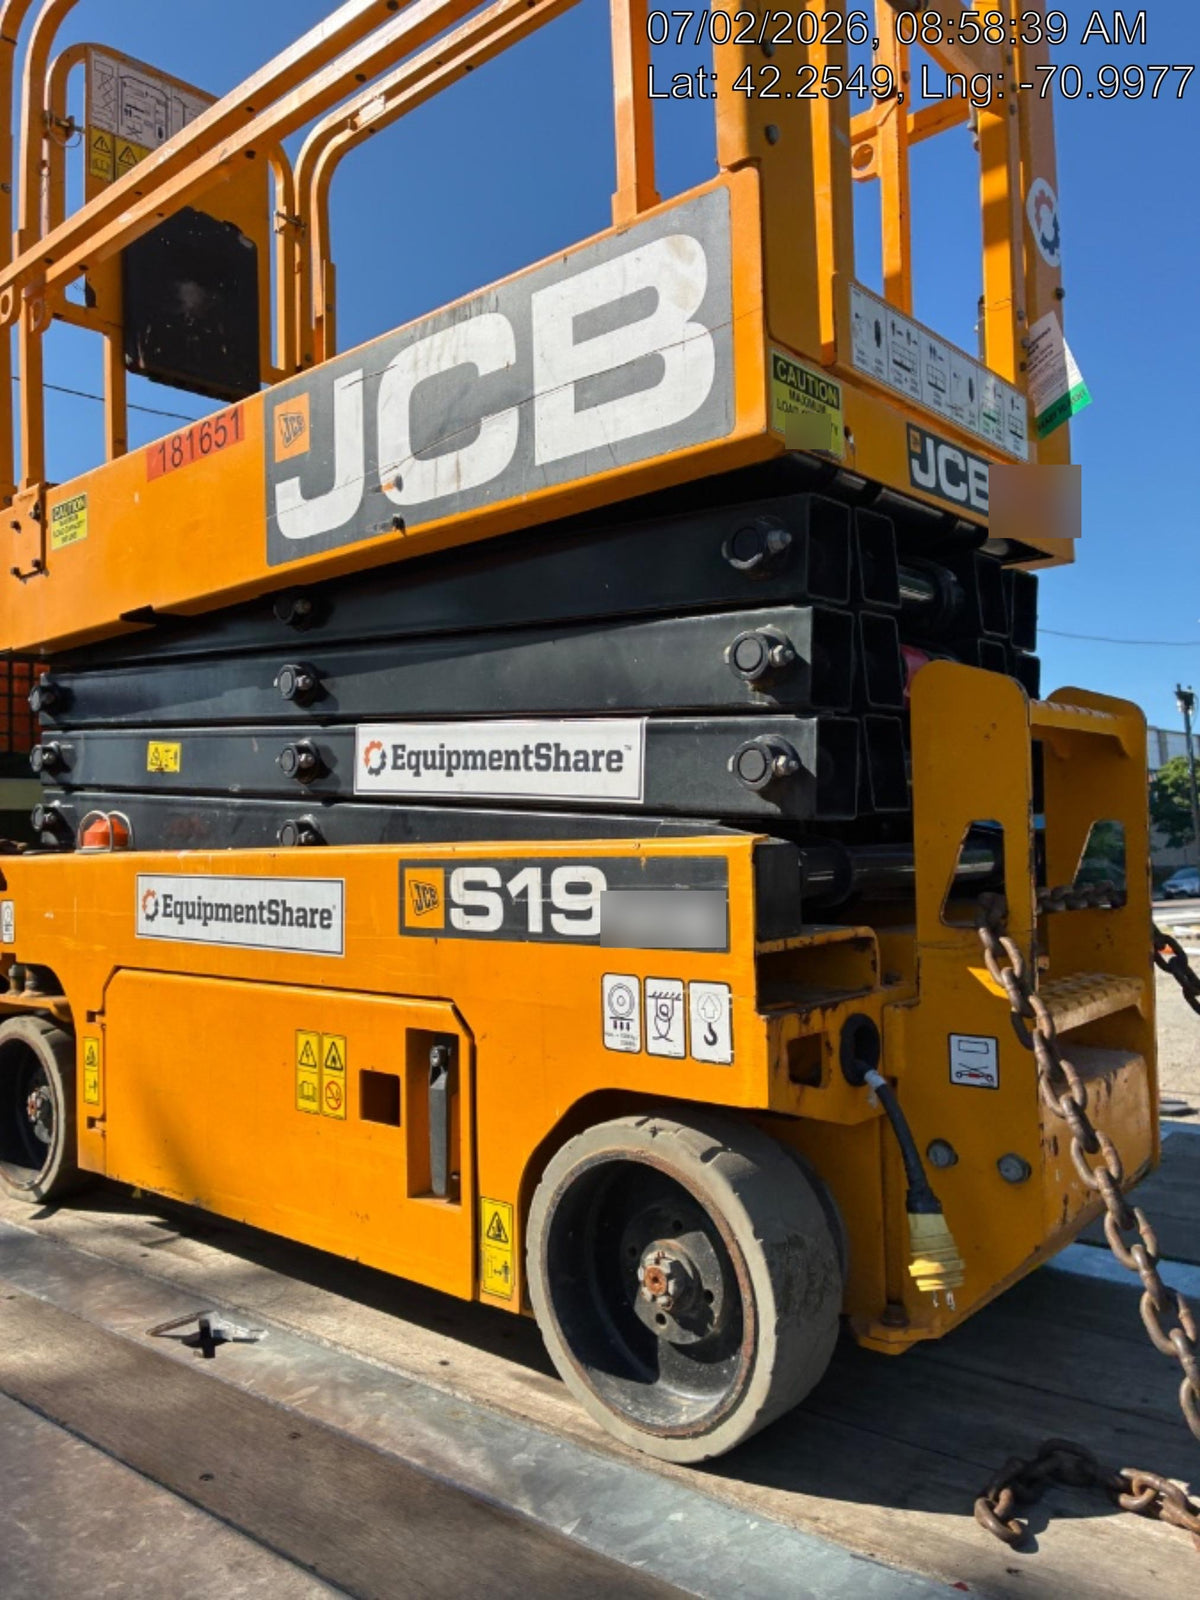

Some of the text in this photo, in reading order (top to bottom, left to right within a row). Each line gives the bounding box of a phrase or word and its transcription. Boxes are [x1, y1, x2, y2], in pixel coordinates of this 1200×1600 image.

[275, 234, 715, 540] JCB
[776, 360, 839, 407] CAUTION
[158, 407, 240, 473] 181651
[911, 436, 989, 511] JCB
[391, 742, 624, 778] EquipmentShare
[161, 893, 334, 930] EquipmentShare
[413, 883, 438, 912] JCB
